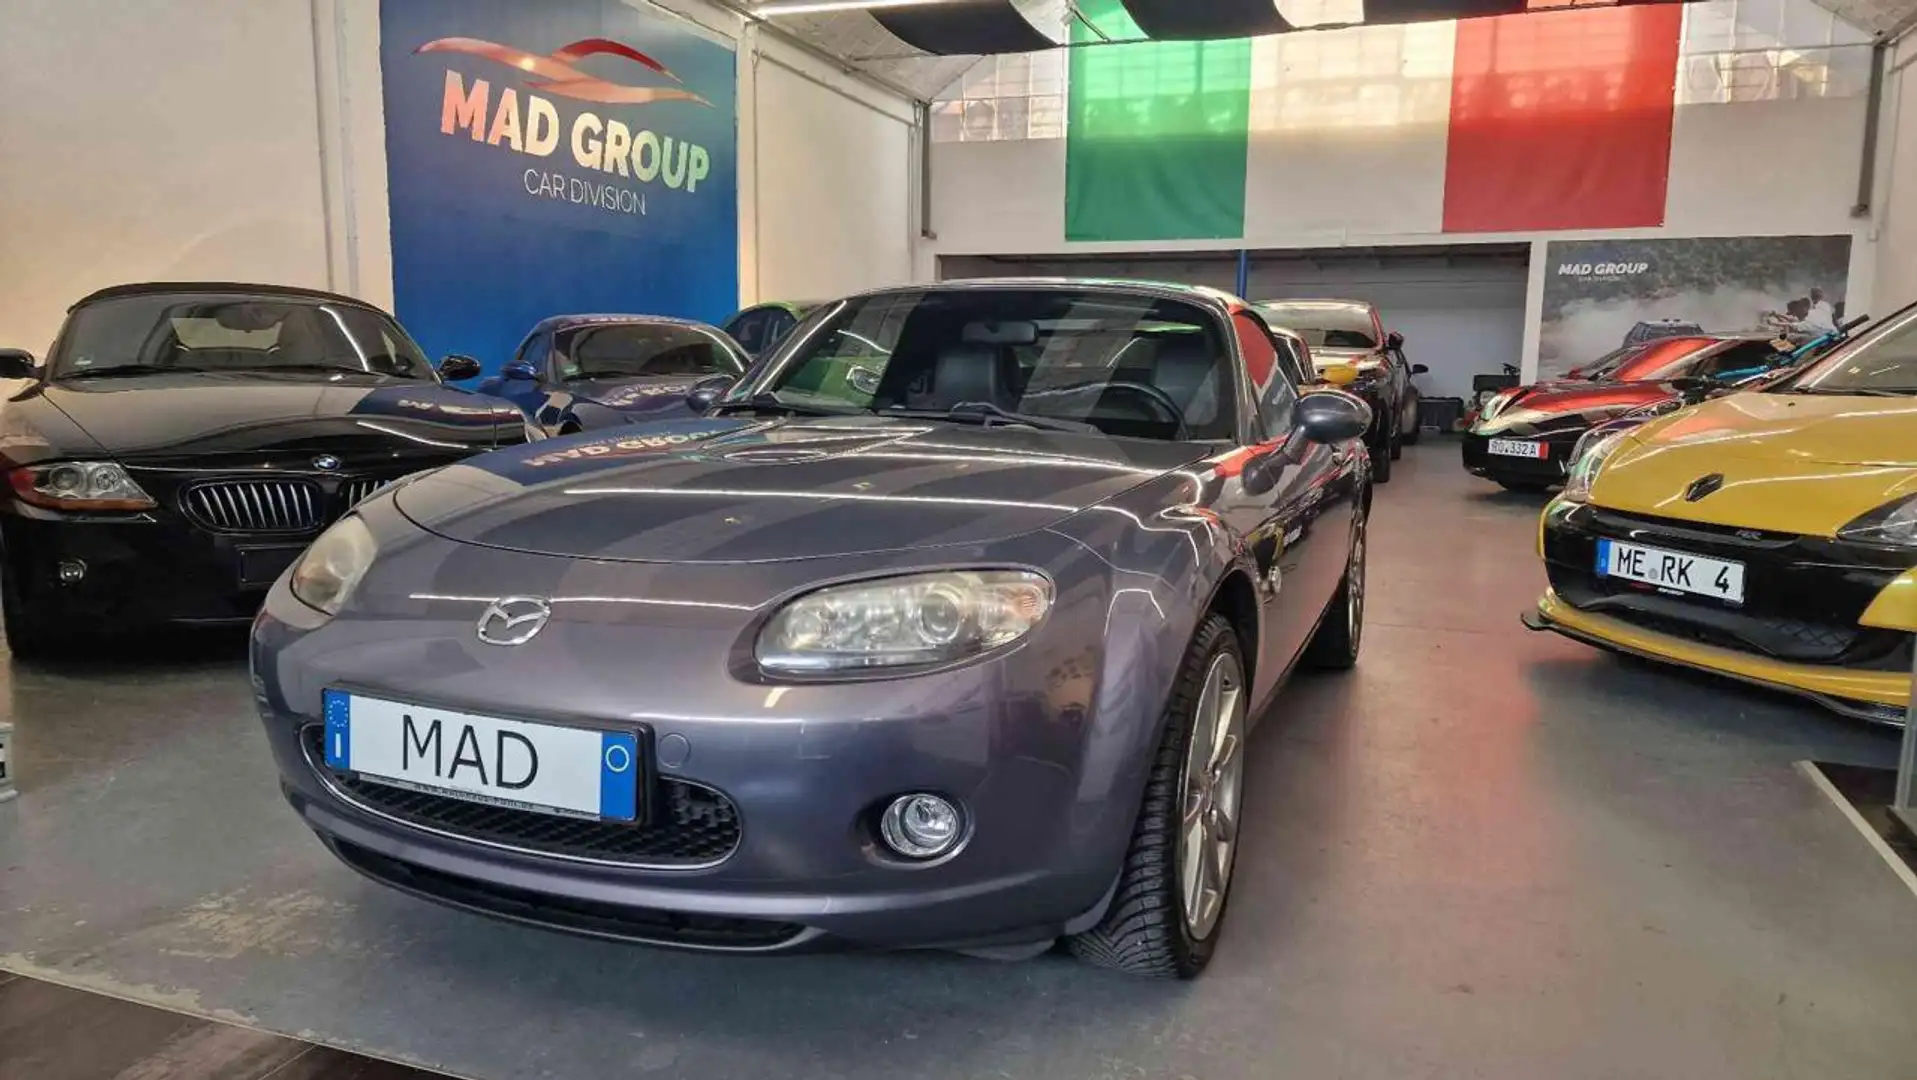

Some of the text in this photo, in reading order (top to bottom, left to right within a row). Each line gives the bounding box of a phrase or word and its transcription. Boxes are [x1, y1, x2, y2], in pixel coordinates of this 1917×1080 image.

[440, 69, 711, 193] MAD GROUP
[523, 168, 647, 216] CAR DIVISION
[1558, 262, 1649, 276] MAD GROUP
[1509, 441, 1529, 455] 332
[1617, 547, 1730, 594] ME RK 4
[402, 713, 539, 791] MAD
